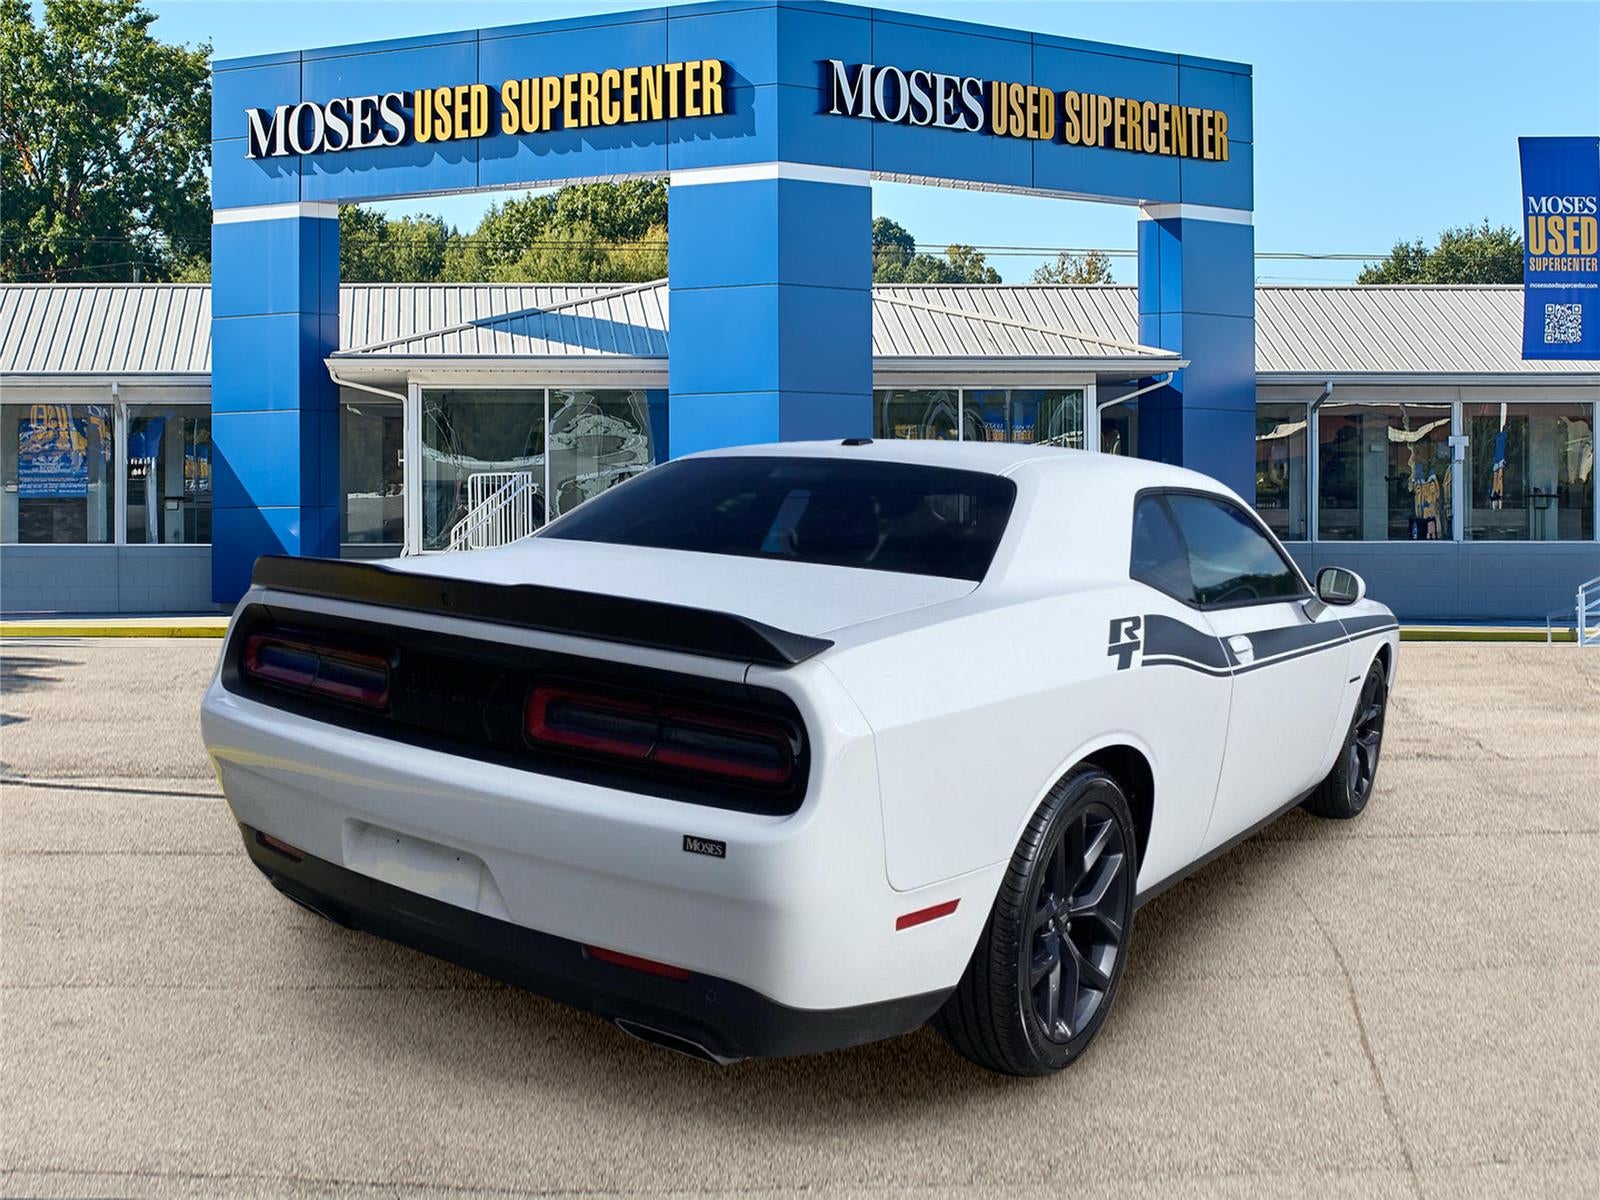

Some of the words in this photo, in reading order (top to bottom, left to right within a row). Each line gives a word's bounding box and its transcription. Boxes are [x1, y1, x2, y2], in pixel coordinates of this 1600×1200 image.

[244, 90, 408, 159] MOSES
[413, 84, 489, 143] USED
[501, 58, 724, 135] SUPERCENTER
[828, 59, 985, 132] MOSES
[991, 80, 1055, 140] USED
[1065, 90, 1230, 161] SUPERCENTER
[1528, 196, 1597, 214] MOSES
[1528, 215, 1598, 256] USED
[1529, 257, 1598, 272] SUPERCENTER
[686, 838, 723, 856] MOSES
